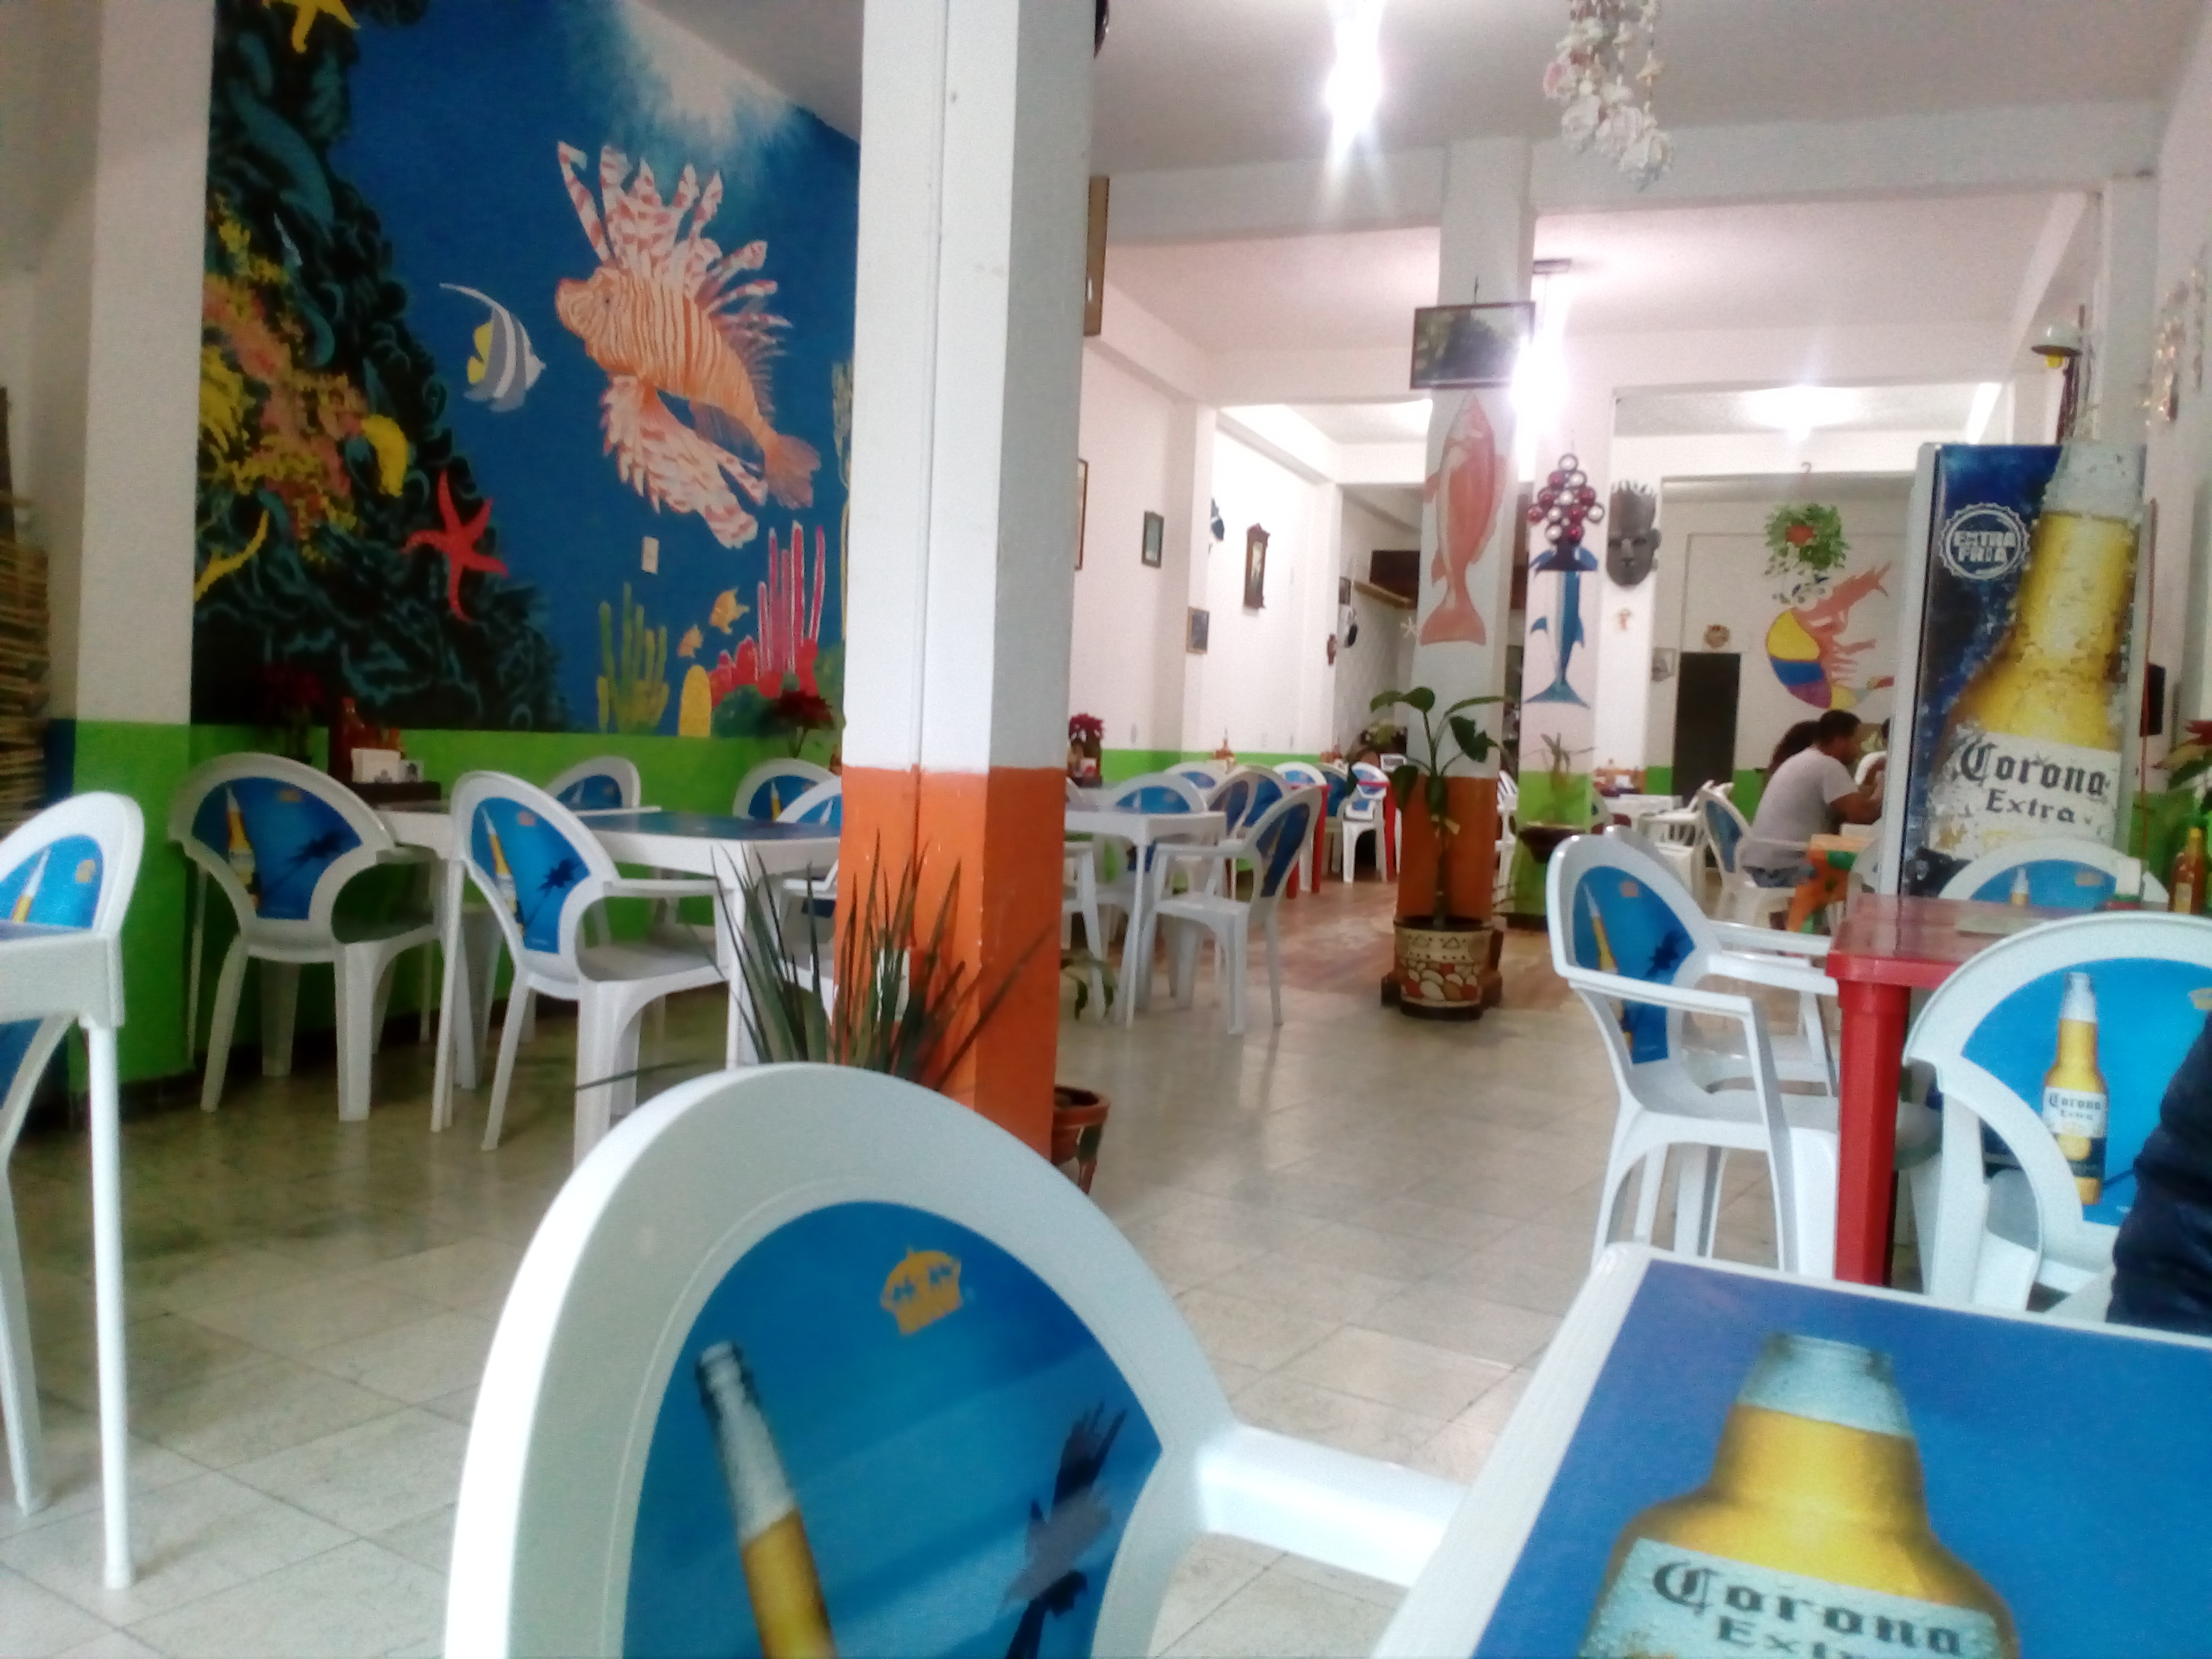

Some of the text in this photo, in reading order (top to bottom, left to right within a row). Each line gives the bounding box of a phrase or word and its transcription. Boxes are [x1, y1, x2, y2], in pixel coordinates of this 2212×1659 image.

[1954, 531, 2017, 547] EXTRA
[1958, 547, 2007, 562] FRIA
[1960, 741, 2107, 796] Corona
[1985, 787, 2075, 823] Extra
[1653, 1561, 1961, 1656] Corona
